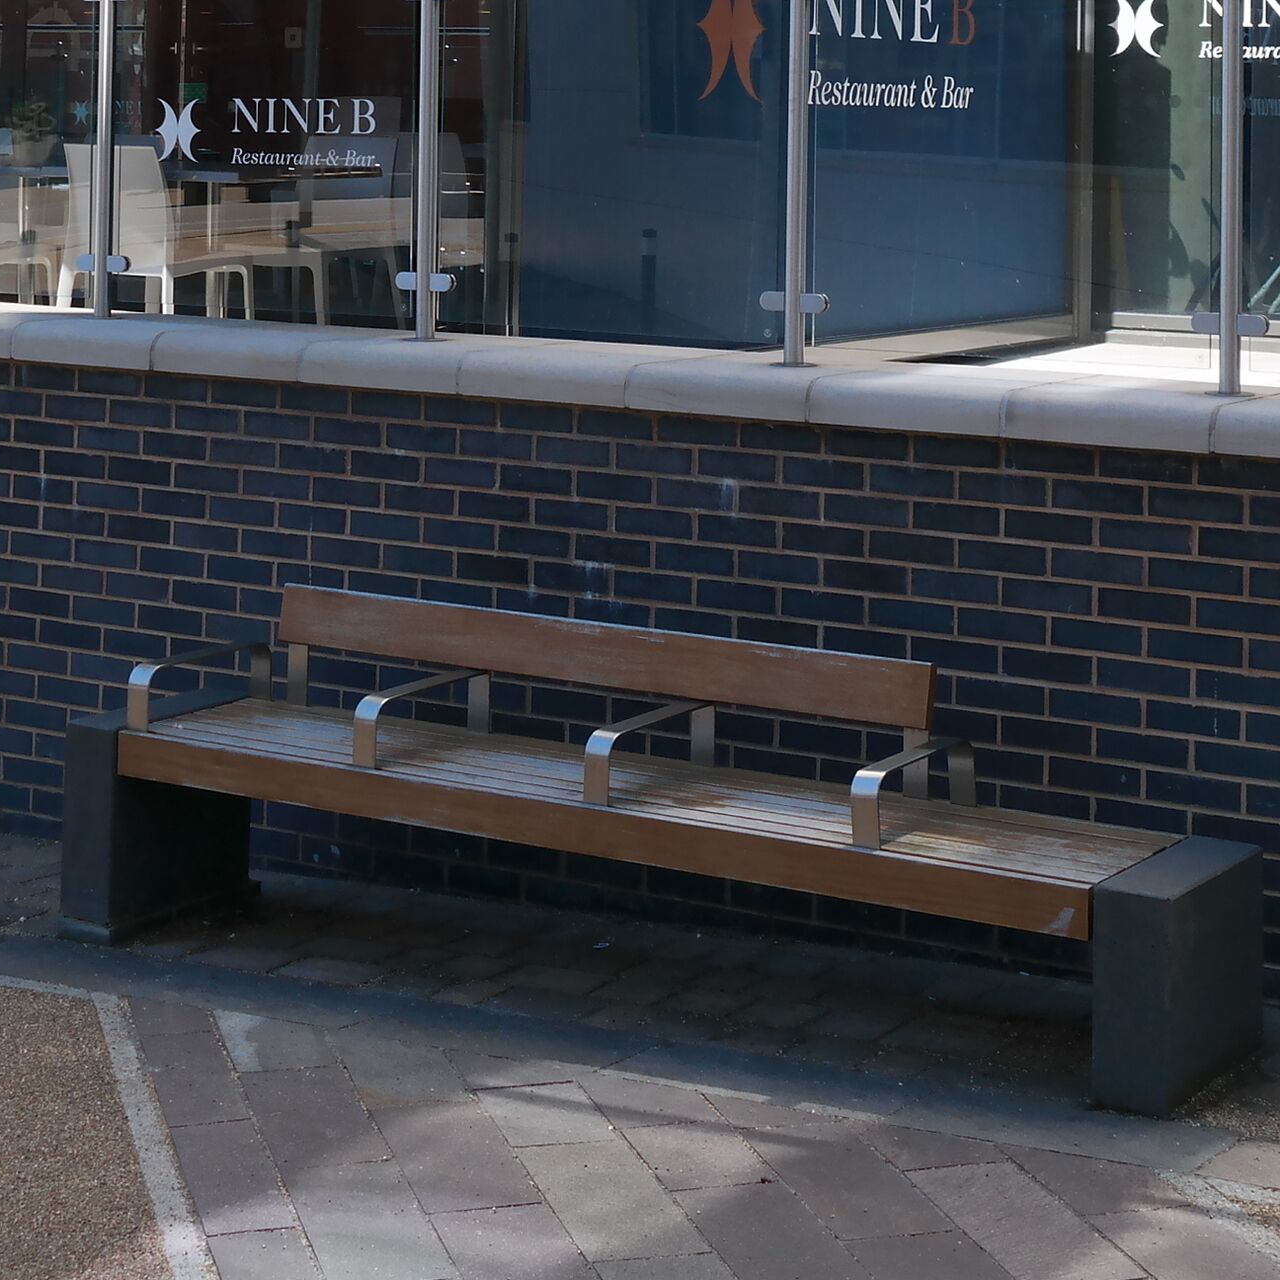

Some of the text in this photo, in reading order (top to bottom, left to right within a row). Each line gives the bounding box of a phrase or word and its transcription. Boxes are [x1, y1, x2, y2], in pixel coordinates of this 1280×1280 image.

[807, 70, 974, 110] Restaurant & Bar
[231, 97, 377, 134] NINE B
[231, 147, 376, 167] Restaurant & Bar
